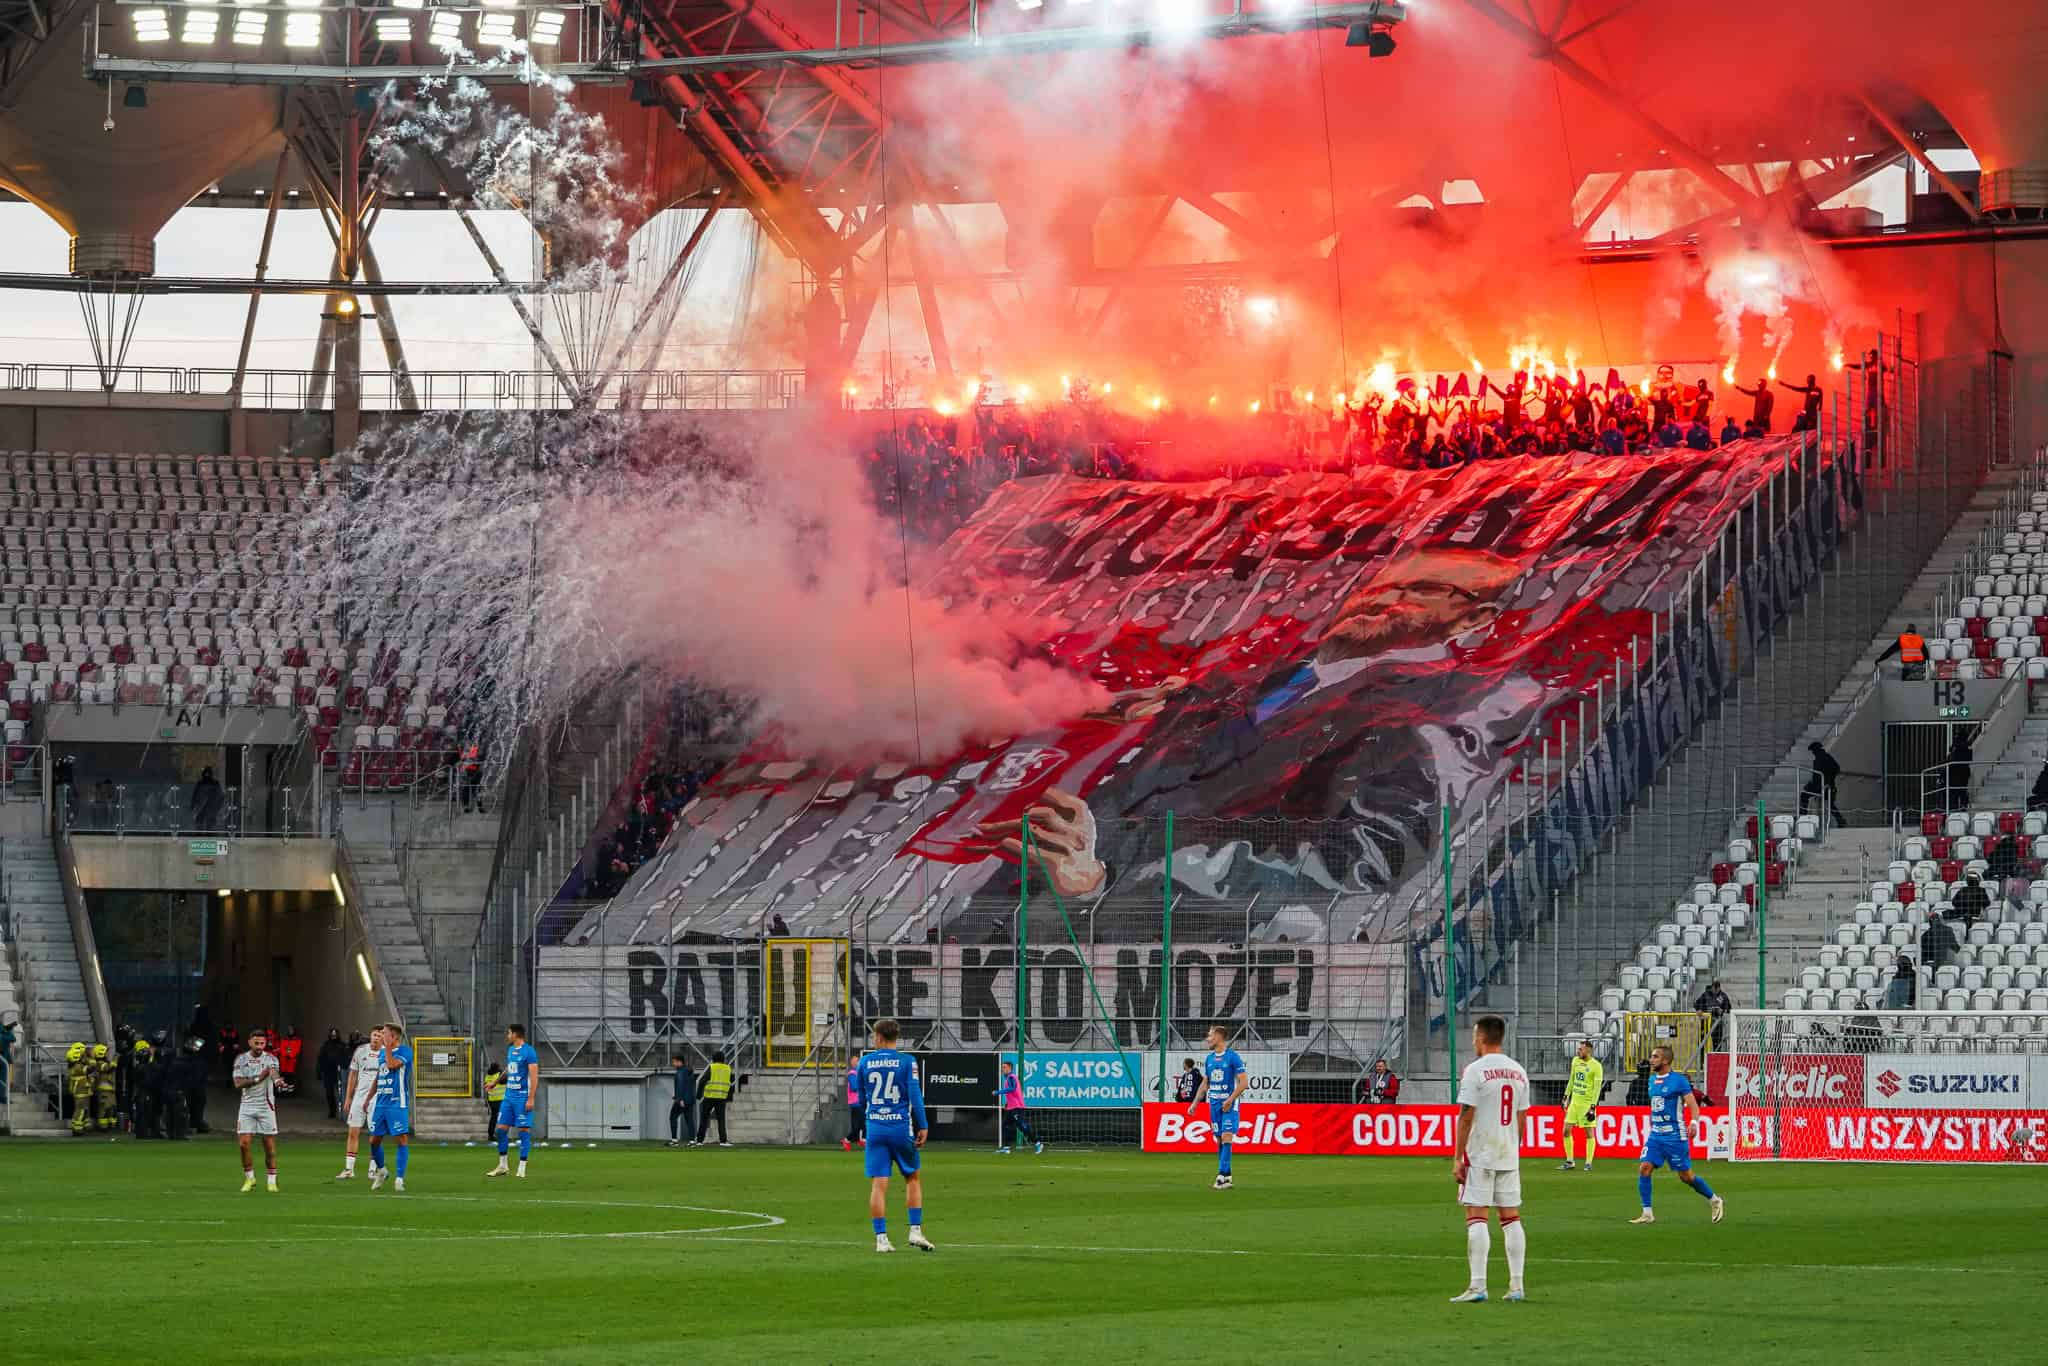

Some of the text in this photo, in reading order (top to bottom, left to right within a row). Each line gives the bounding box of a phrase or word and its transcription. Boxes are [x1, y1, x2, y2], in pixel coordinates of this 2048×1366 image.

[1933, 680, 1966, 706] H3
[960, 947, 1084, 1044] KTO
[1045, 1060, 1124, 1079] SALTOS
[1724, 1065, 1849, 1099] Betclic
[1907, 1074, 2020, 1094] SUZUKI
[868, 1071, 902, 1105] 24
[1048, 1086, 1135, 1099] TRAMPOLIN
[1500, 1084, 1514, 1126] 8
[1155, 1112, 1300, 1145] Beclic
